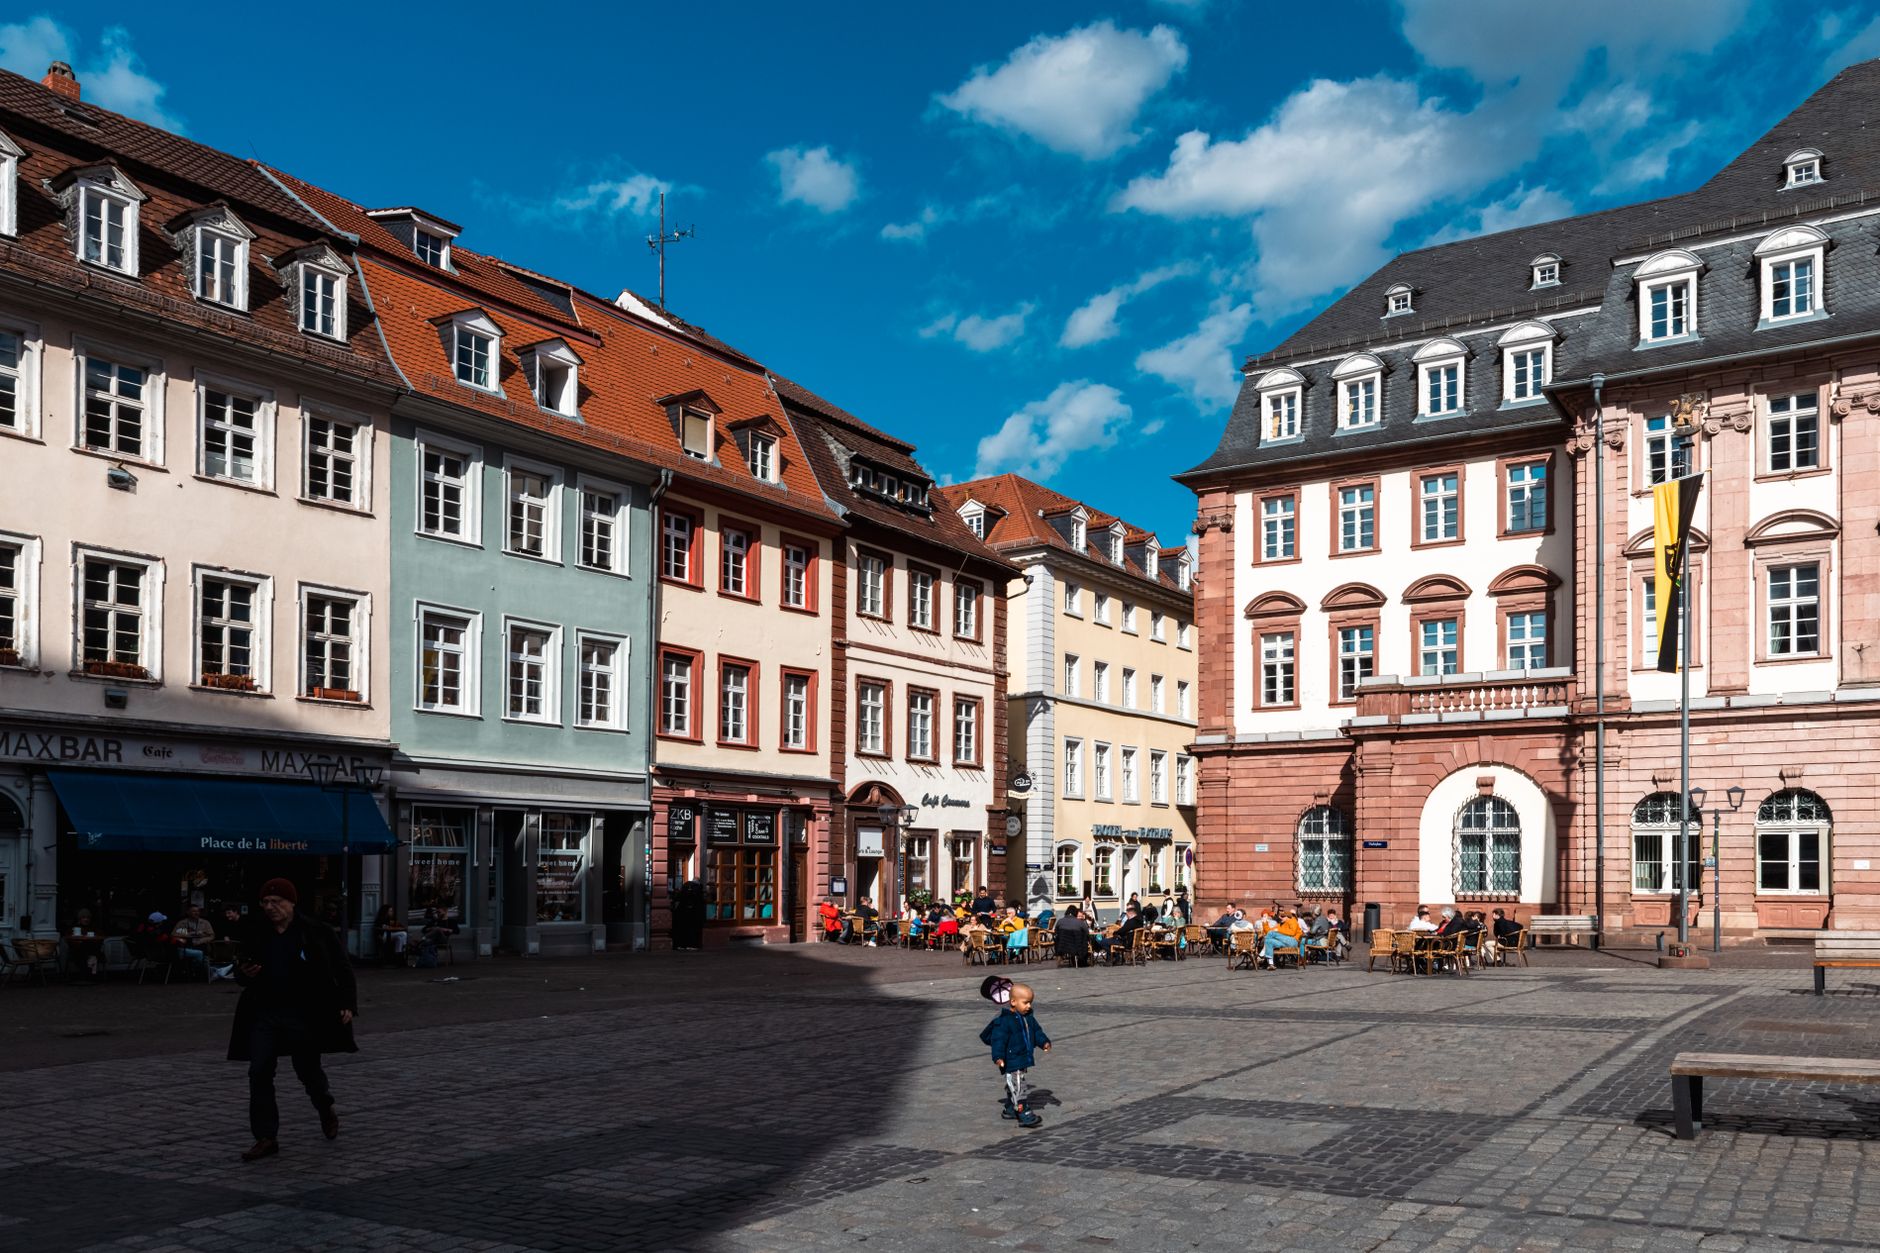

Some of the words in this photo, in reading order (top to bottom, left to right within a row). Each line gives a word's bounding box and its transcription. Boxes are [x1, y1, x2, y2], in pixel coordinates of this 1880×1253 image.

[262, 750, 365, 776] MAXAR
[670, 808, 692, 820] ZKB
[200, 836, 234, 848] Place
[237, 837, 252, 849] de
[255, 837, 266, 849] la
[269, 838, 308, 850] liberté
